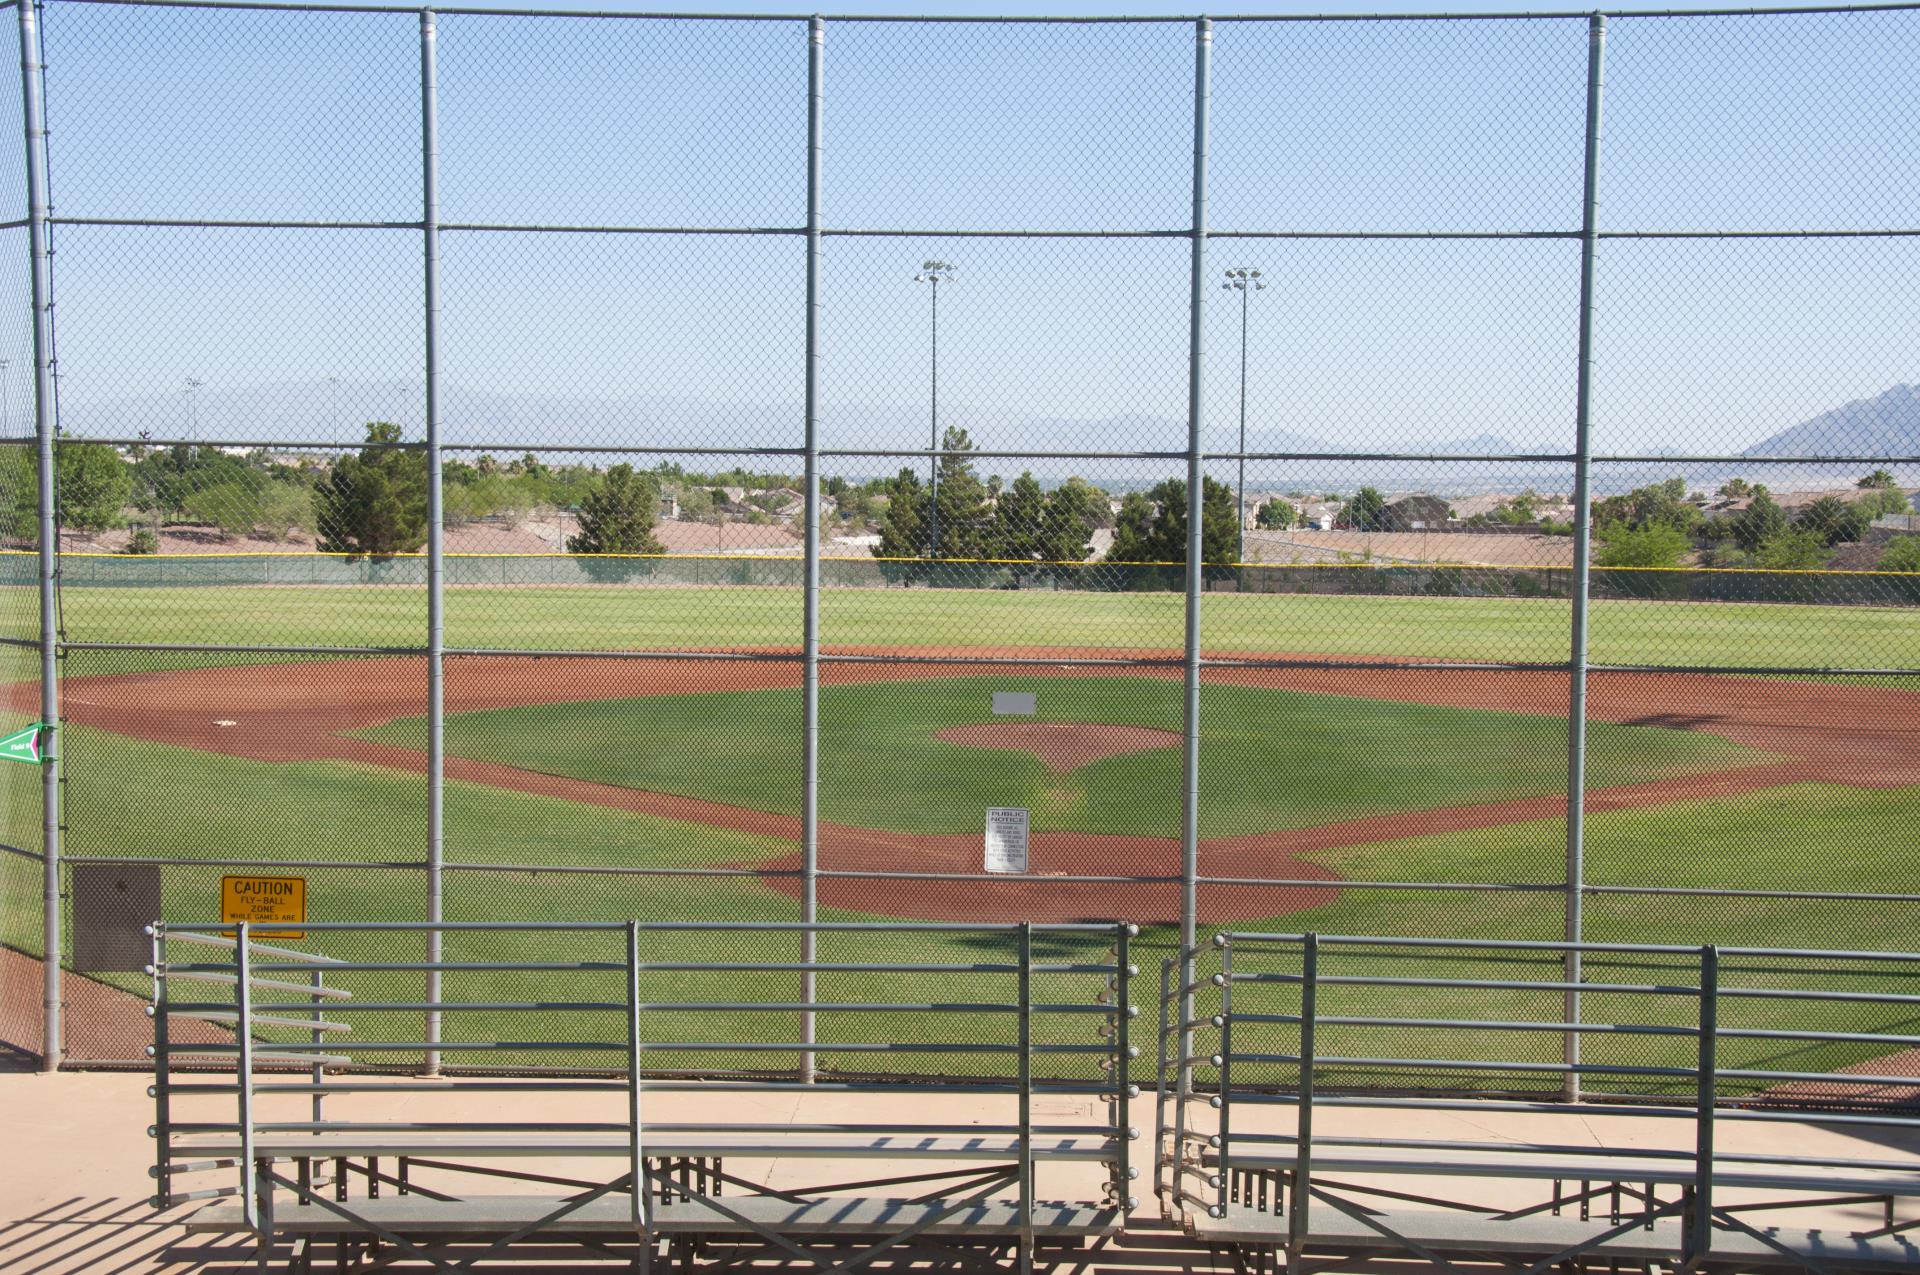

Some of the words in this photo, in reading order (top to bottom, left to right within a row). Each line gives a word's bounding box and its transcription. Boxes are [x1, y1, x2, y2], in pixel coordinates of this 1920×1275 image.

[11, 743, 25, 751] Field
[234, 880, 293, 895] CAUTION
[240, 896, 286, 905] FLY-BALL
[250, 905, 275, 913] ZONE
